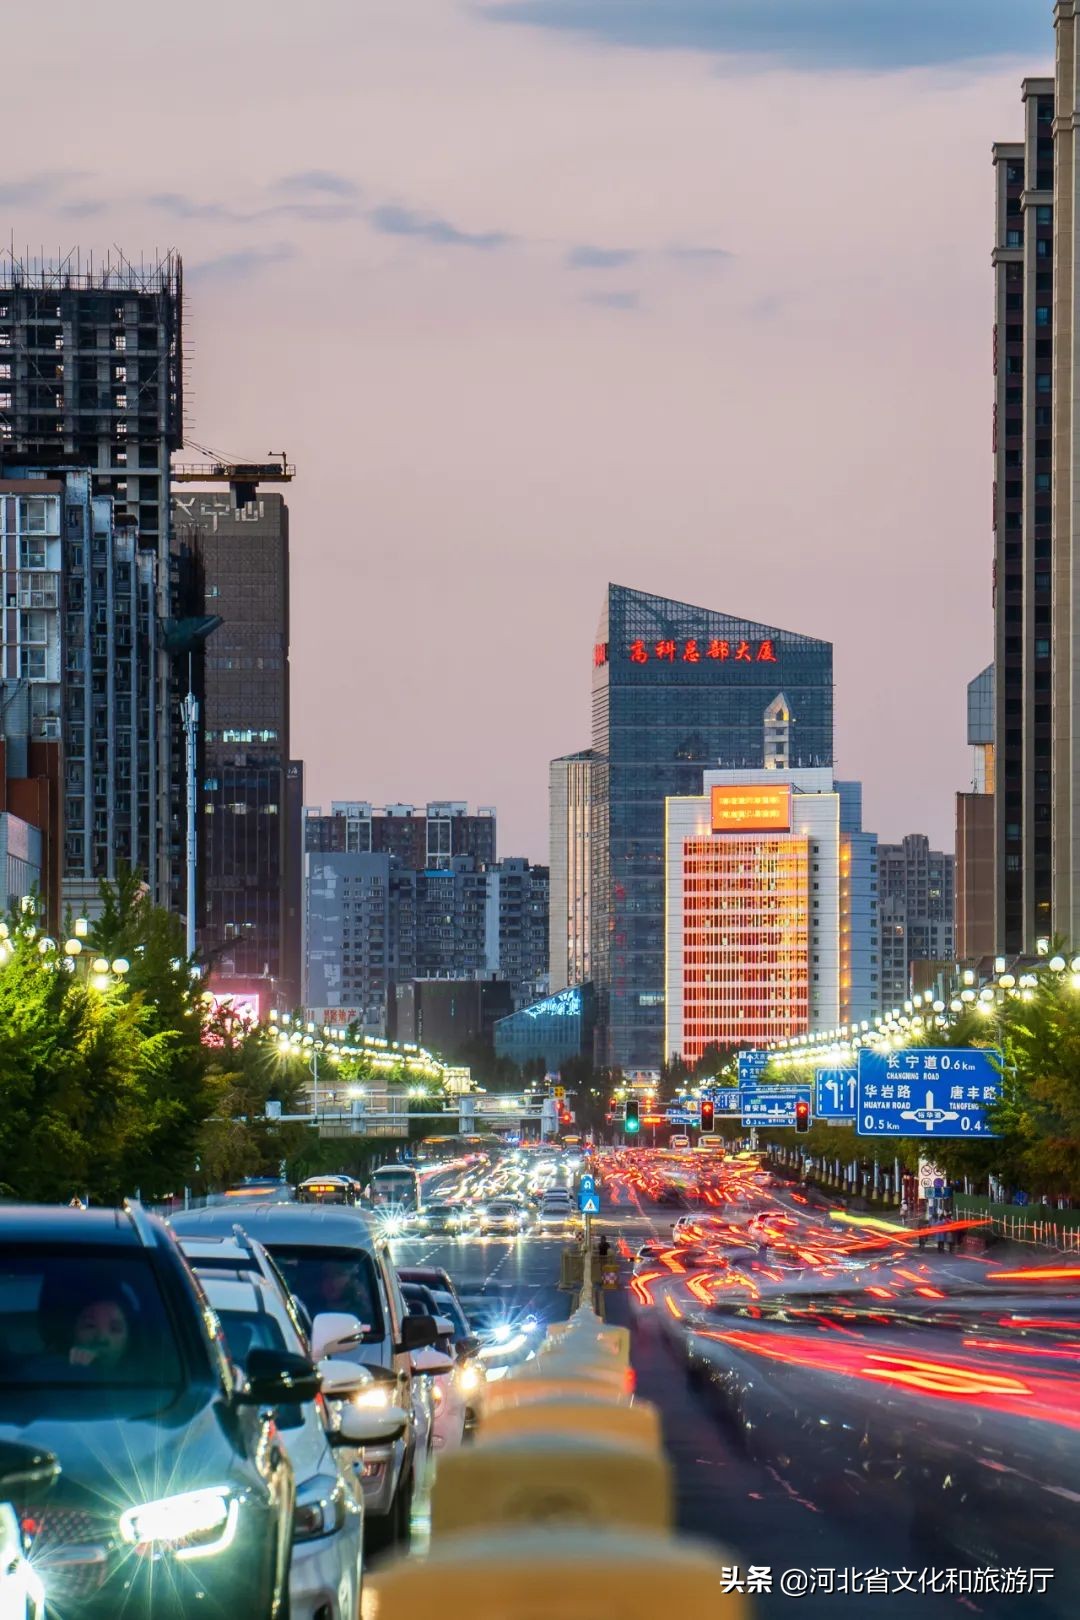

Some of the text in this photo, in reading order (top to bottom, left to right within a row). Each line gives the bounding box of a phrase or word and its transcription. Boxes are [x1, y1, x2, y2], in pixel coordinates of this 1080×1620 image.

[630, 639, 777, 664] 高科总部大厦
[886, 1055, 976, 1071] 长宁道 0.6 km
[886, 1072, 940, 1080] CHANGNING ROAD
[864, 1084, 911, 1098] 华岩路
[950, 1085, 996, 1100] 唐丰路
[863, 1101, 911, 1109] HUAYAN ROAD
[864, 1115, 885, 1130] 0.5
[886, 1121, 900, 1130] km
[960, 1116, 982, 1131] 0.4
